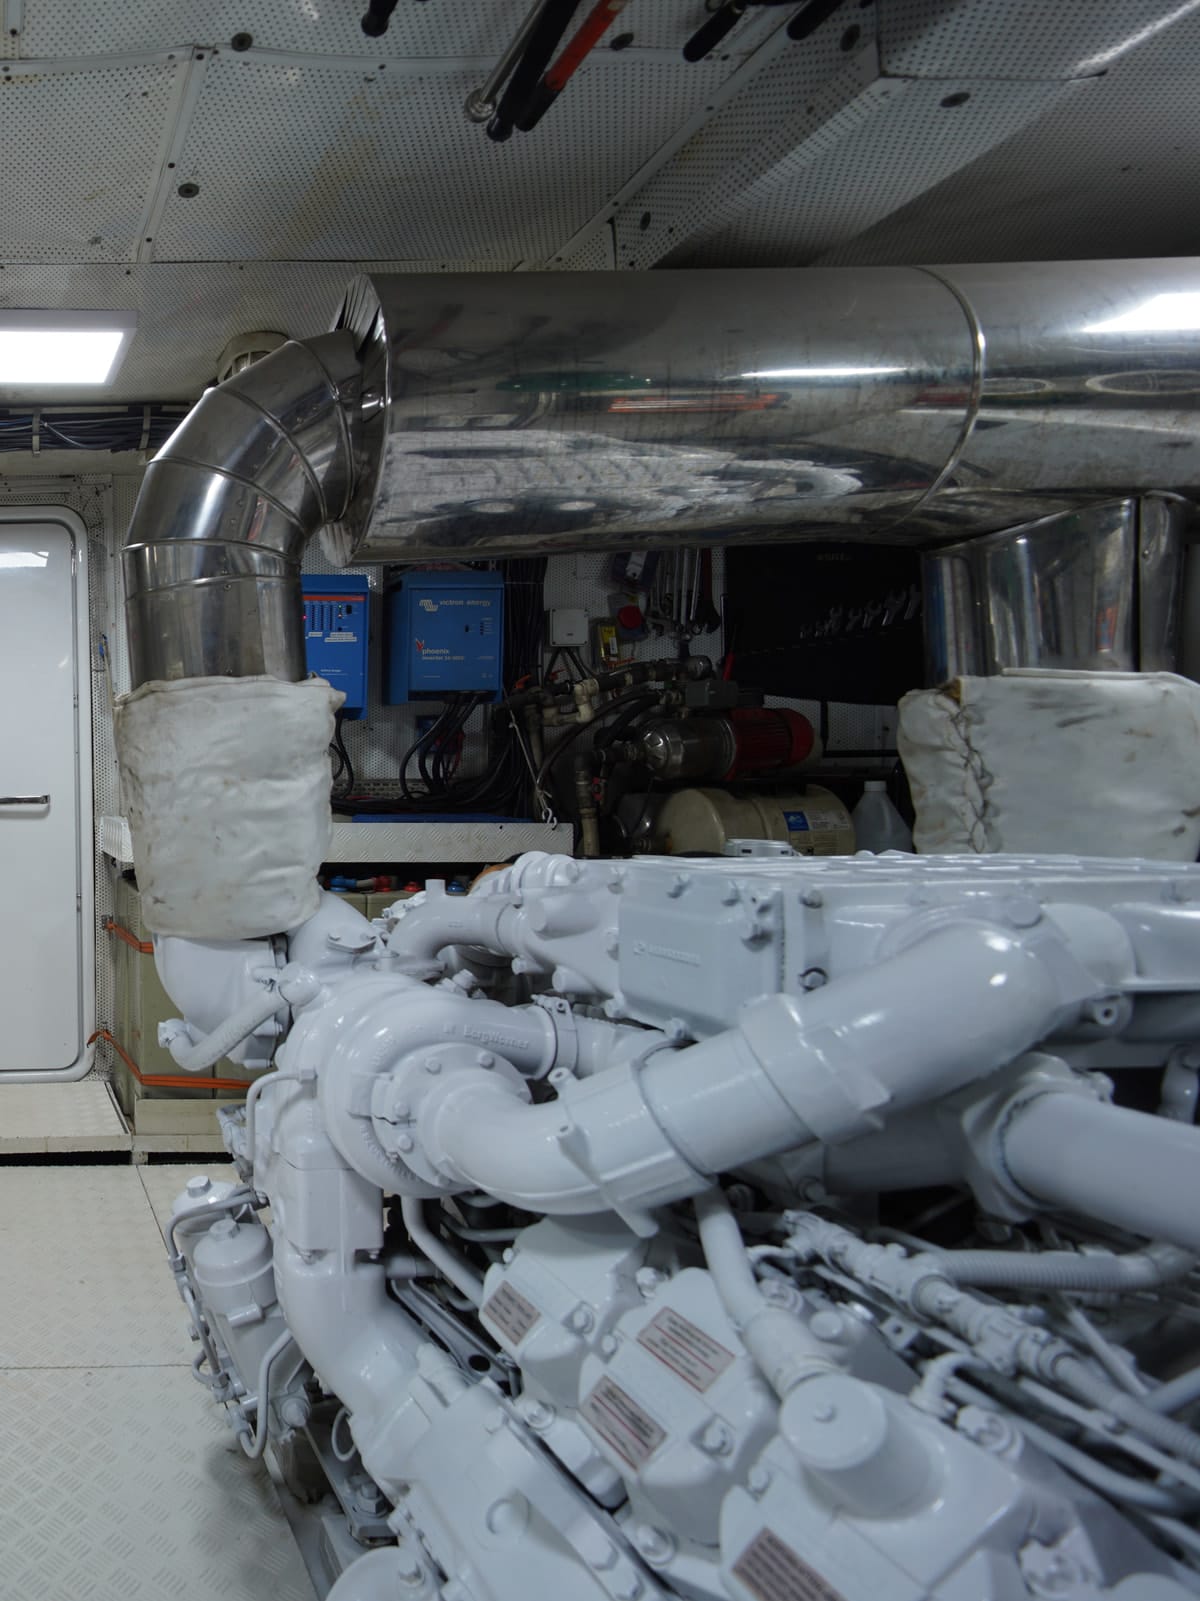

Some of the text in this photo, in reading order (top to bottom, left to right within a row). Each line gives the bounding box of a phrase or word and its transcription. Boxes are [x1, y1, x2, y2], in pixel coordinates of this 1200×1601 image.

[466, 600, 491, 608] energy
[422, 647, 449, 656] phoenix
[463, 1023, 529, 1050] BorgWarner
